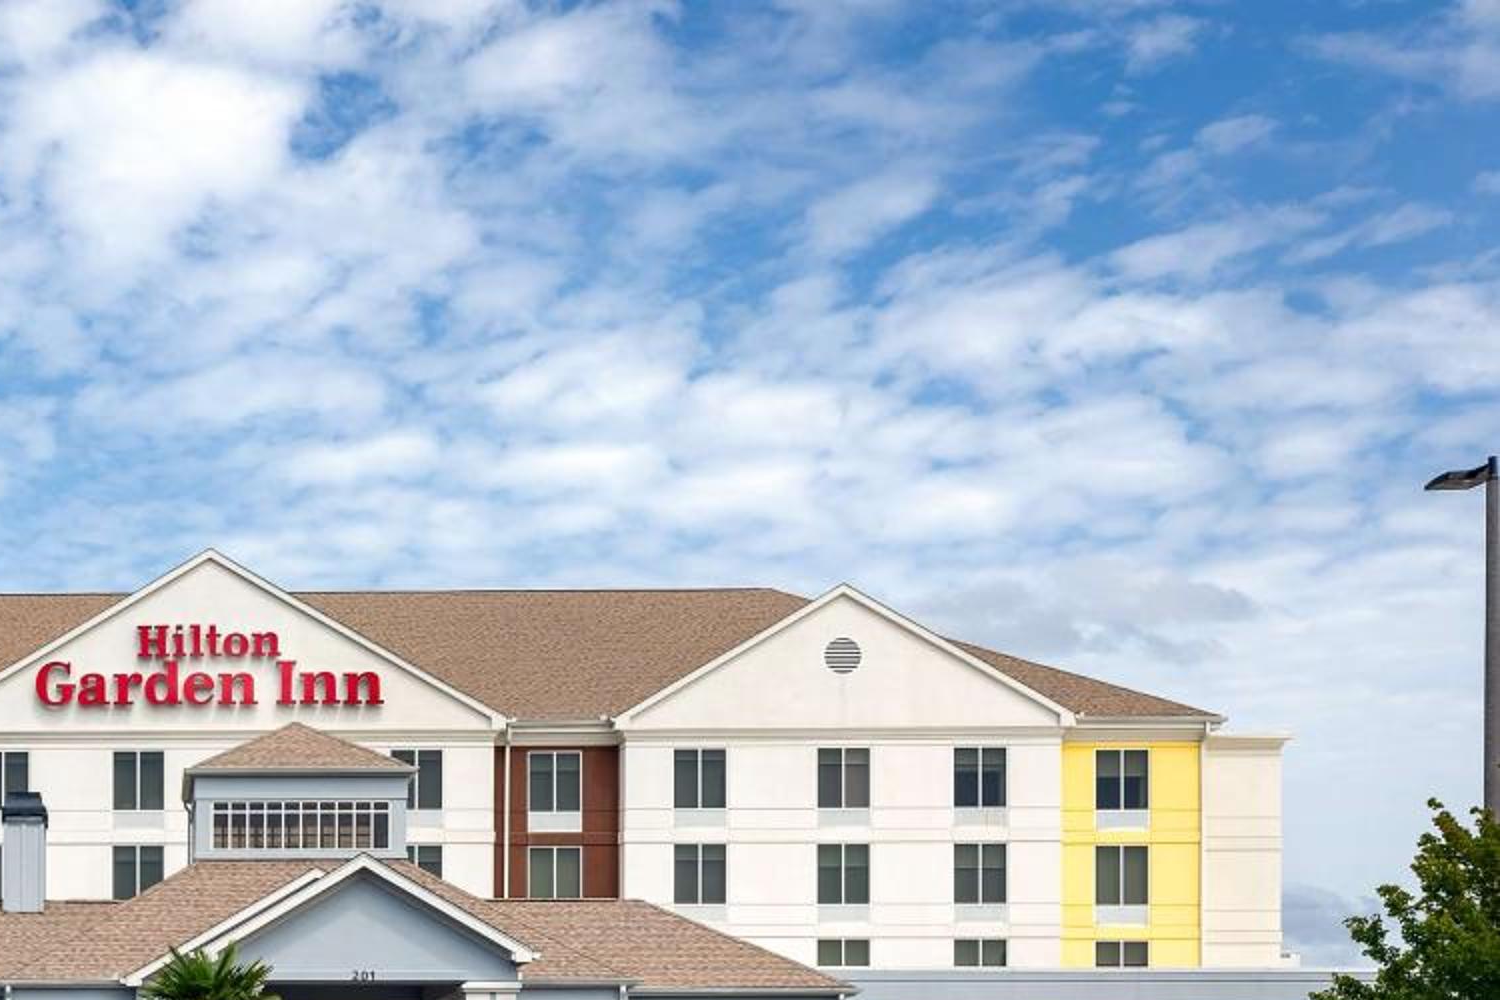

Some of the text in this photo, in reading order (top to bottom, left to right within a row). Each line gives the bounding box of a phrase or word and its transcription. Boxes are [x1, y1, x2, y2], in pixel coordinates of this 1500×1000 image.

[136, 624, 281, 658] Hilton
[35, 660, 385, 706] Garden Inn
[352, 970, 375, 982] 201
